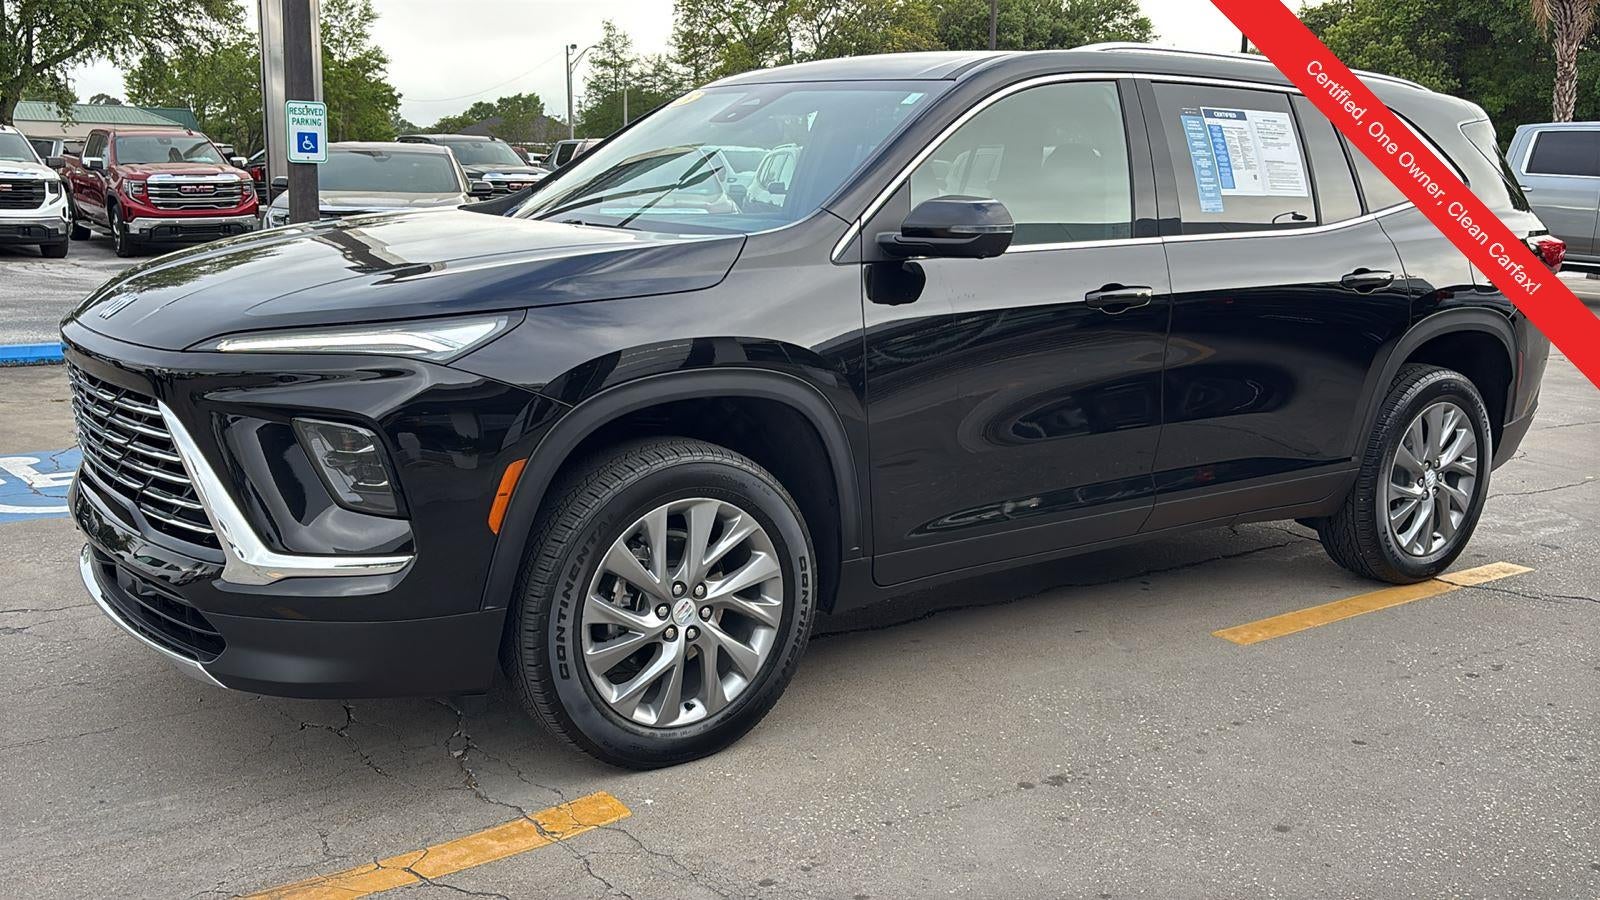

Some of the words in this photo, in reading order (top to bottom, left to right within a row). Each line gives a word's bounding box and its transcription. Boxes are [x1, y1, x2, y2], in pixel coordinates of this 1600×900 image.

[289, 107, 324, 117] RESERVED
[291, 117, 322, 127] PARKING
[180, 184, 215, 193] GMC
